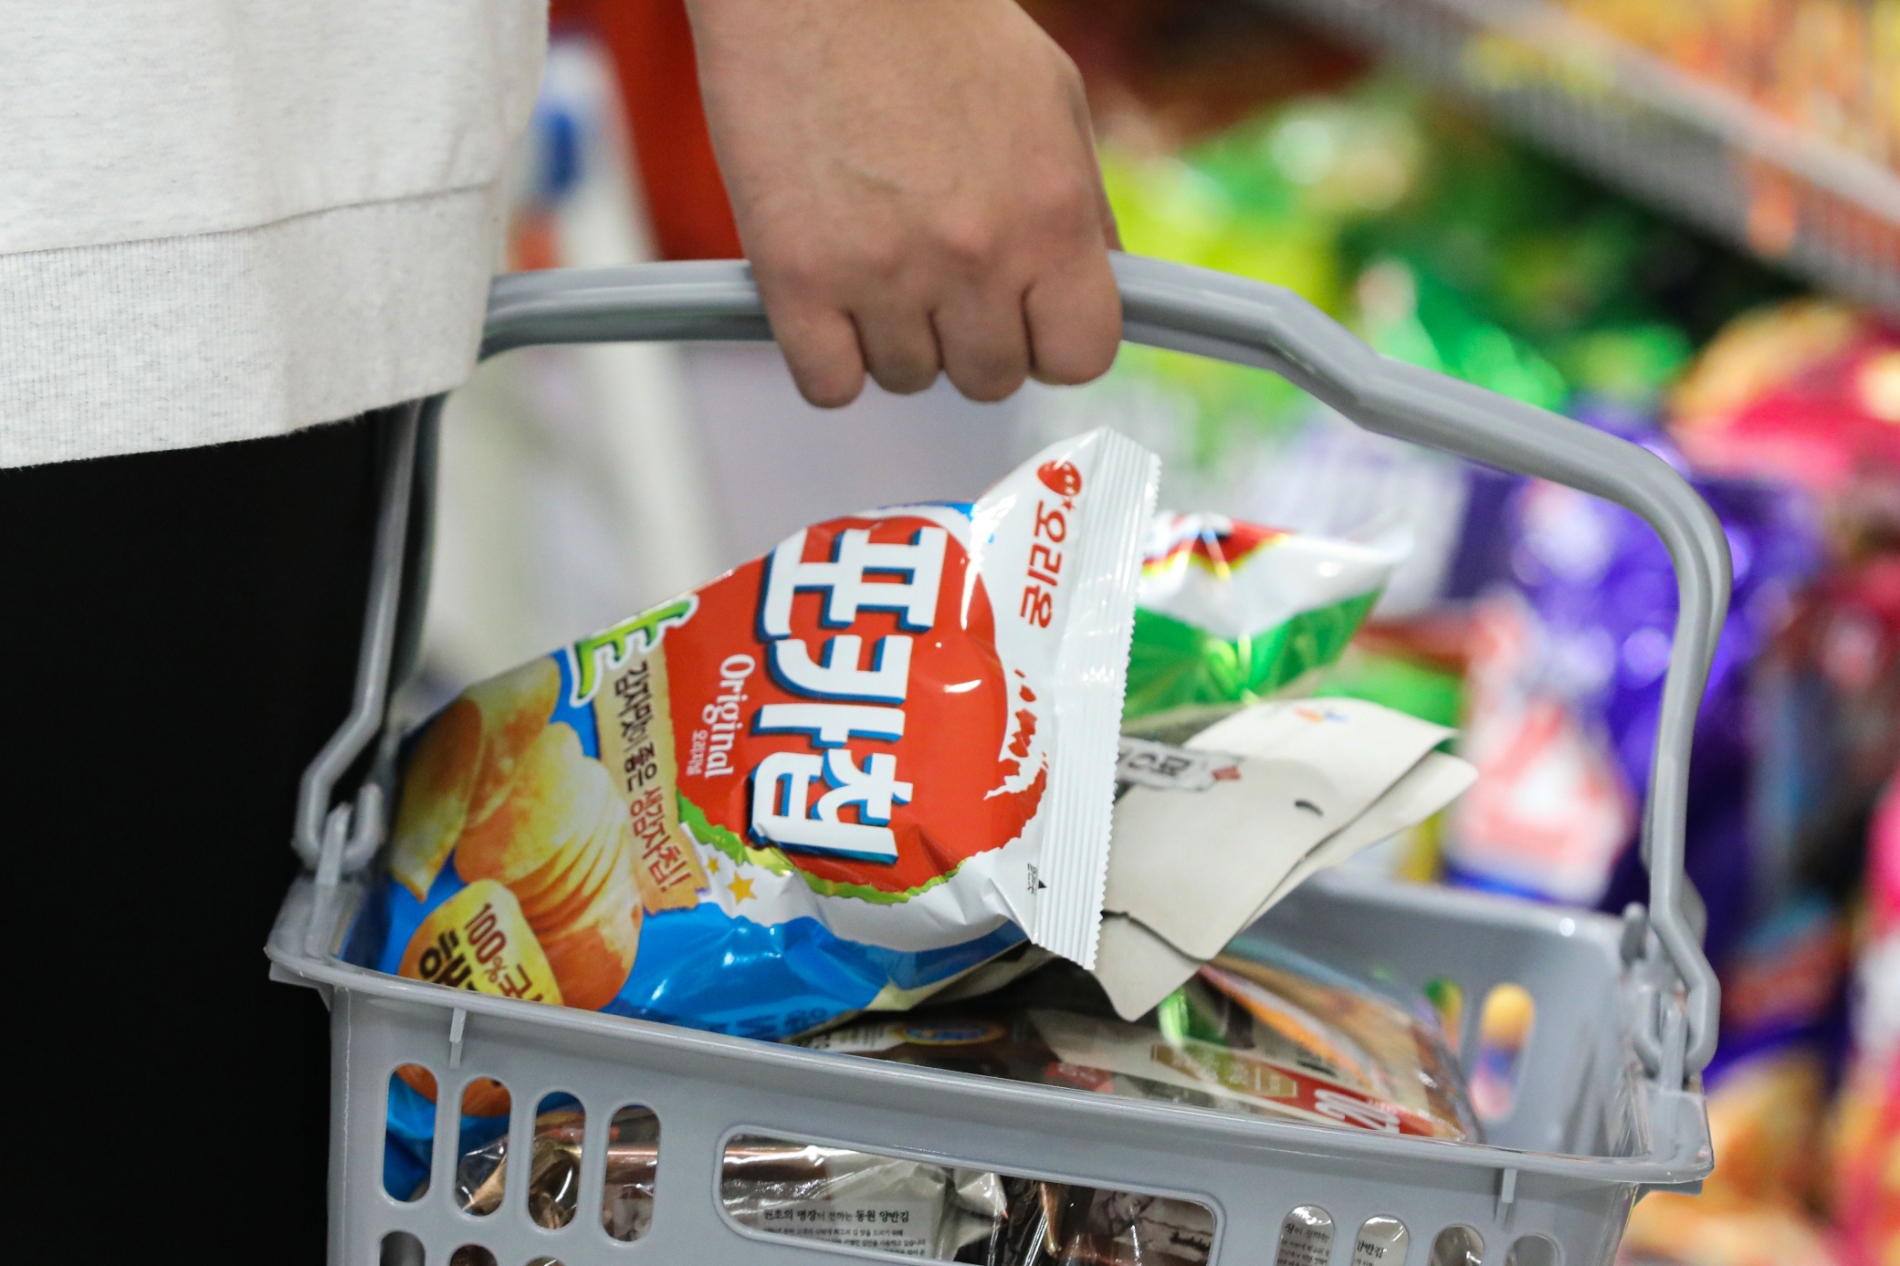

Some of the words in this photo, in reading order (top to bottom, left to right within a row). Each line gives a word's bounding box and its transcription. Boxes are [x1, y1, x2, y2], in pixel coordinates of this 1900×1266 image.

[1020, 499, 1066, 628] 오리온
[615, 660, 653, 752] 감자맛이
[702, 653, 756, 779] Original
[752, 525, 947, 865] 포카칩
[624, 742, 658, 792] 좋은
[686, 729, 708, 776] 오리지널
[630, 786, 692, 893] 생감자칩!
[764, 1209, 793, 1221] 원초의
[797, 1209, 825, 1222] 명장이
[855, 1210, 876, 1223] 동원
[879, 1210, 909, 1223] 양반김
